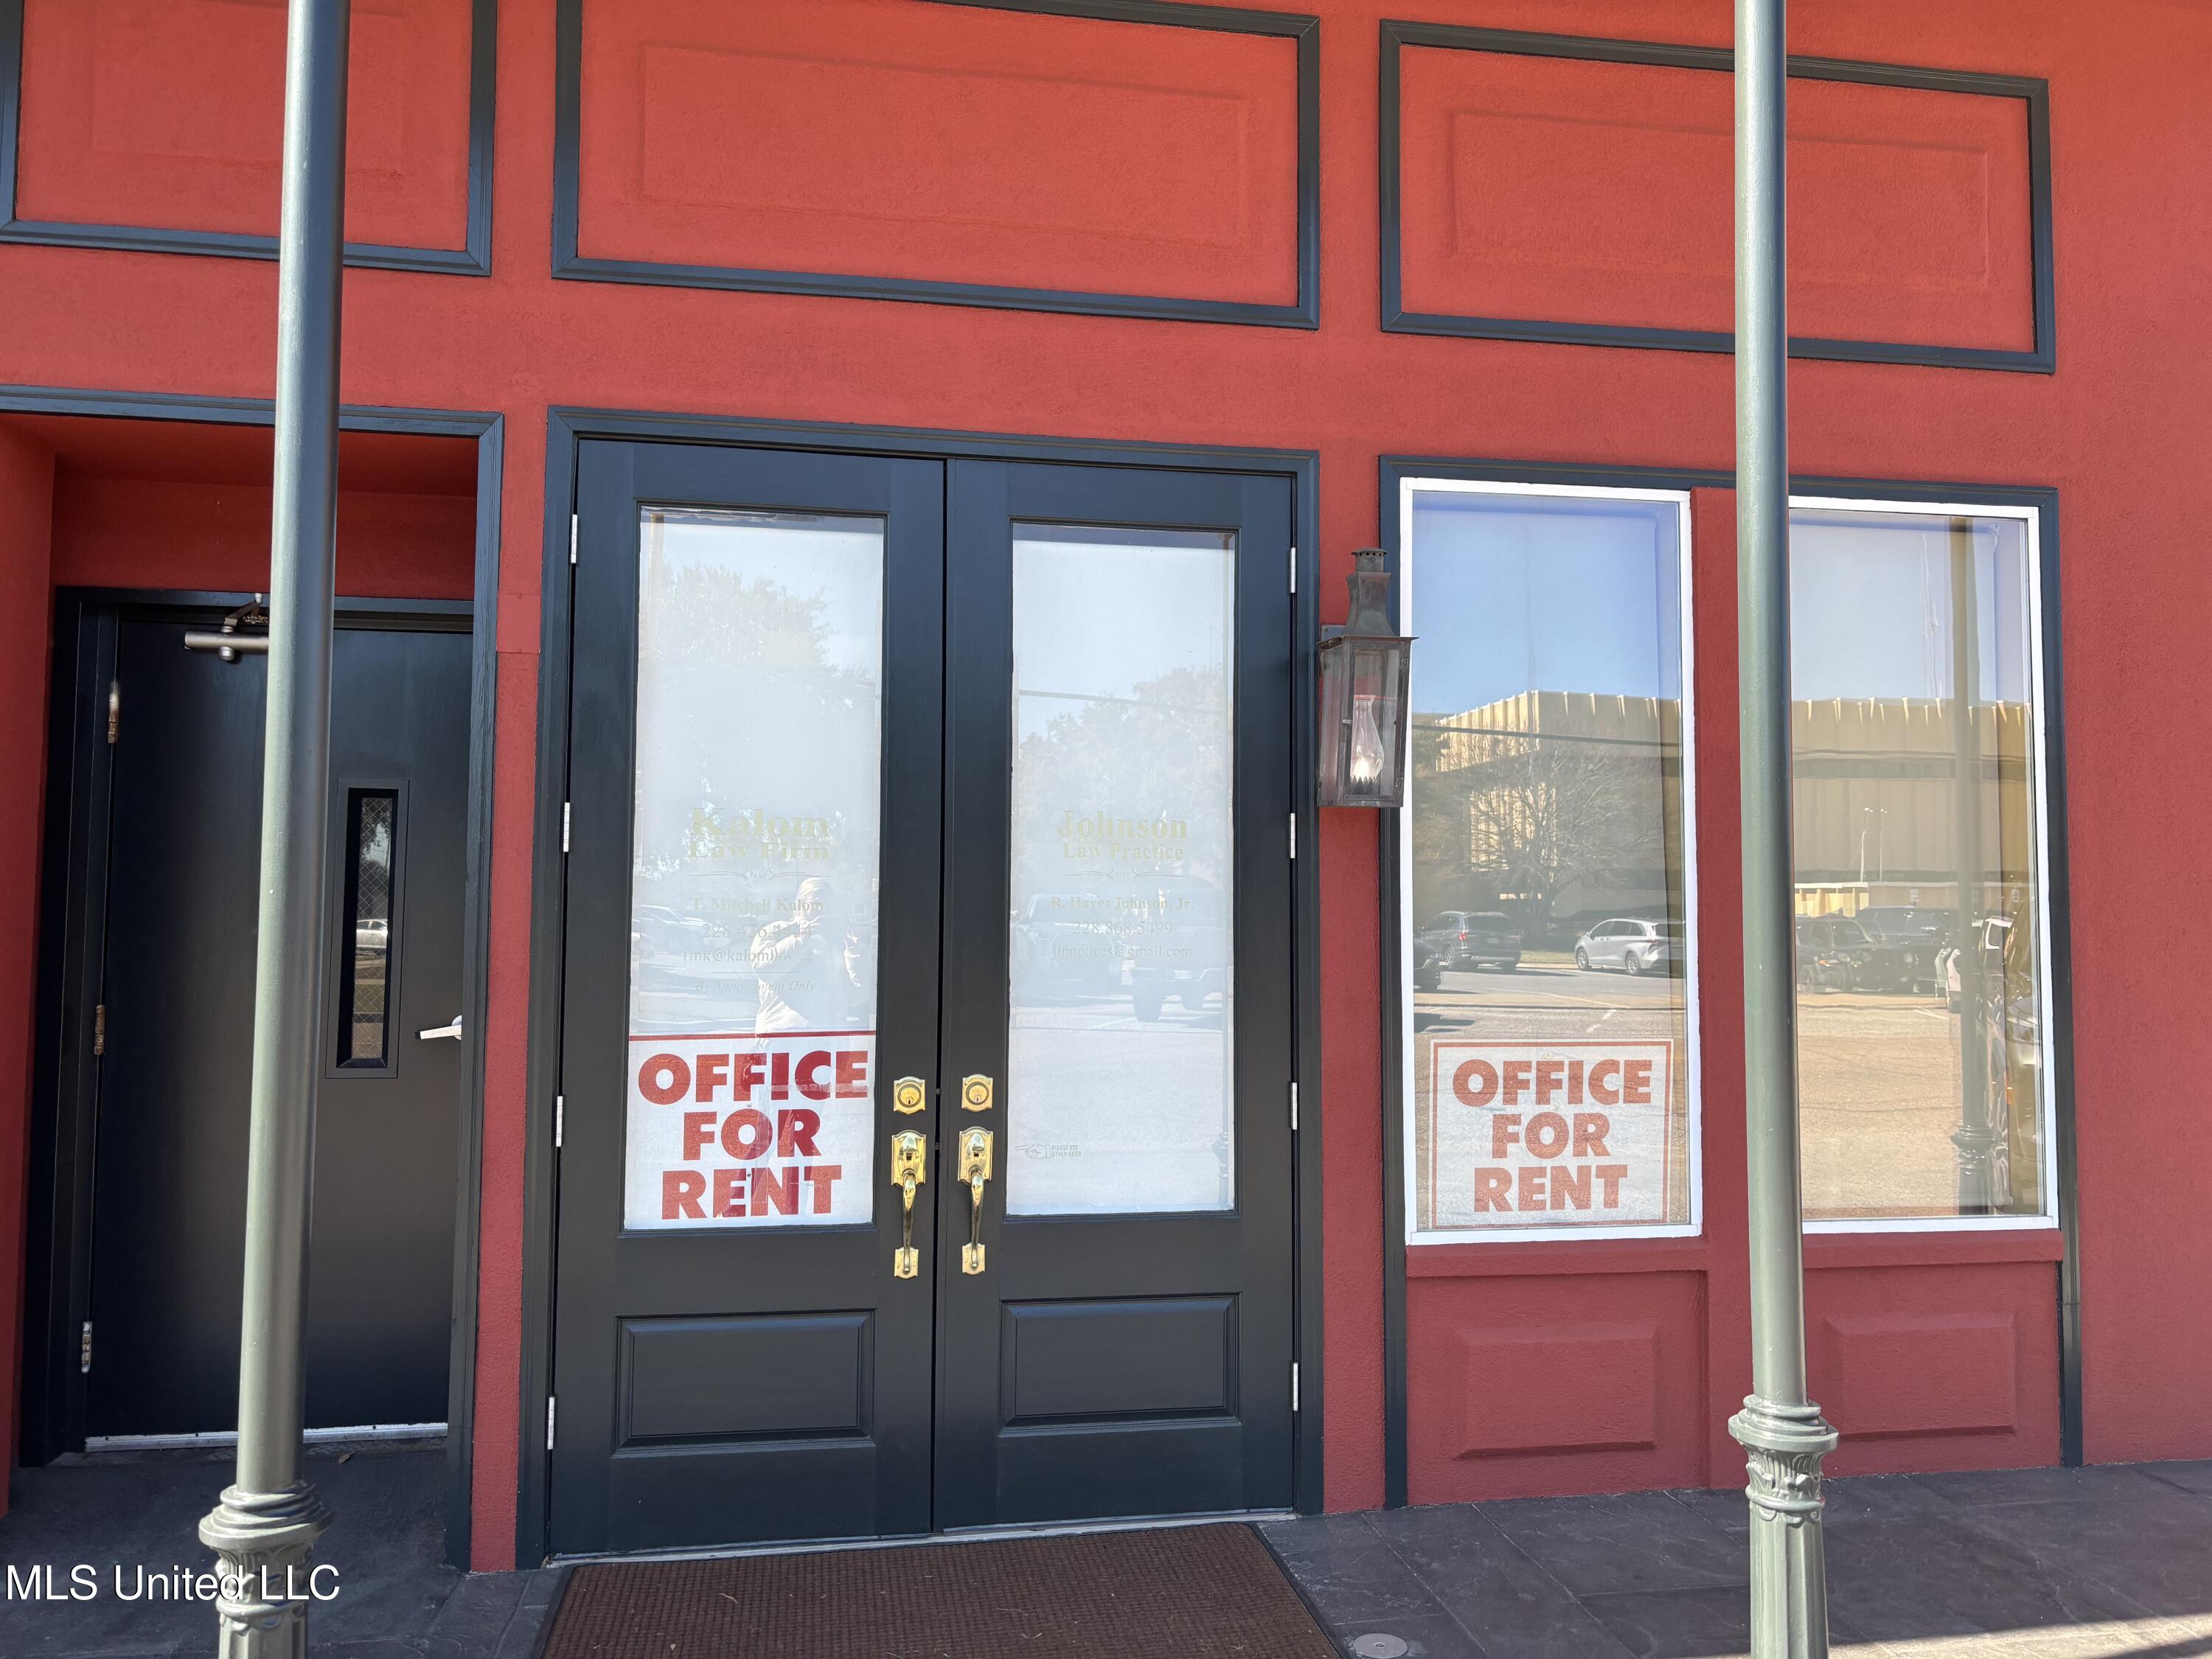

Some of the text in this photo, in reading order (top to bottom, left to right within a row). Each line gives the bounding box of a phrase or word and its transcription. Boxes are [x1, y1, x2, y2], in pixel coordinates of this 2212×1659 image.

[690, 807, 830, 837] Kalom
[1057, 810, 1188, 839] Johnson
[689, 841, 830, 860] Law Firm
[1063, 842, 1184, 860] Law Practice
[690, 897, 824, 911] T. Mitchell Kalom
[1051, 897, 1065, 909] R.
[1070, 897, 1110, 911] Hayes
[1175, 897, 1194, 910] Jr.
[1072, 920, 1174, 935] 228.868.5499
[638, 1051, 869, 1105] OFFICE
[1453, 1059, 1652, 1107] OFFICE
[684, 1108, 822, 1161] FOR
[1492, 1111, 1610, 1159] FOR
[661, 1165, 842, 1220] RENT
[1474, 1164, 1628, 1213] RENT
